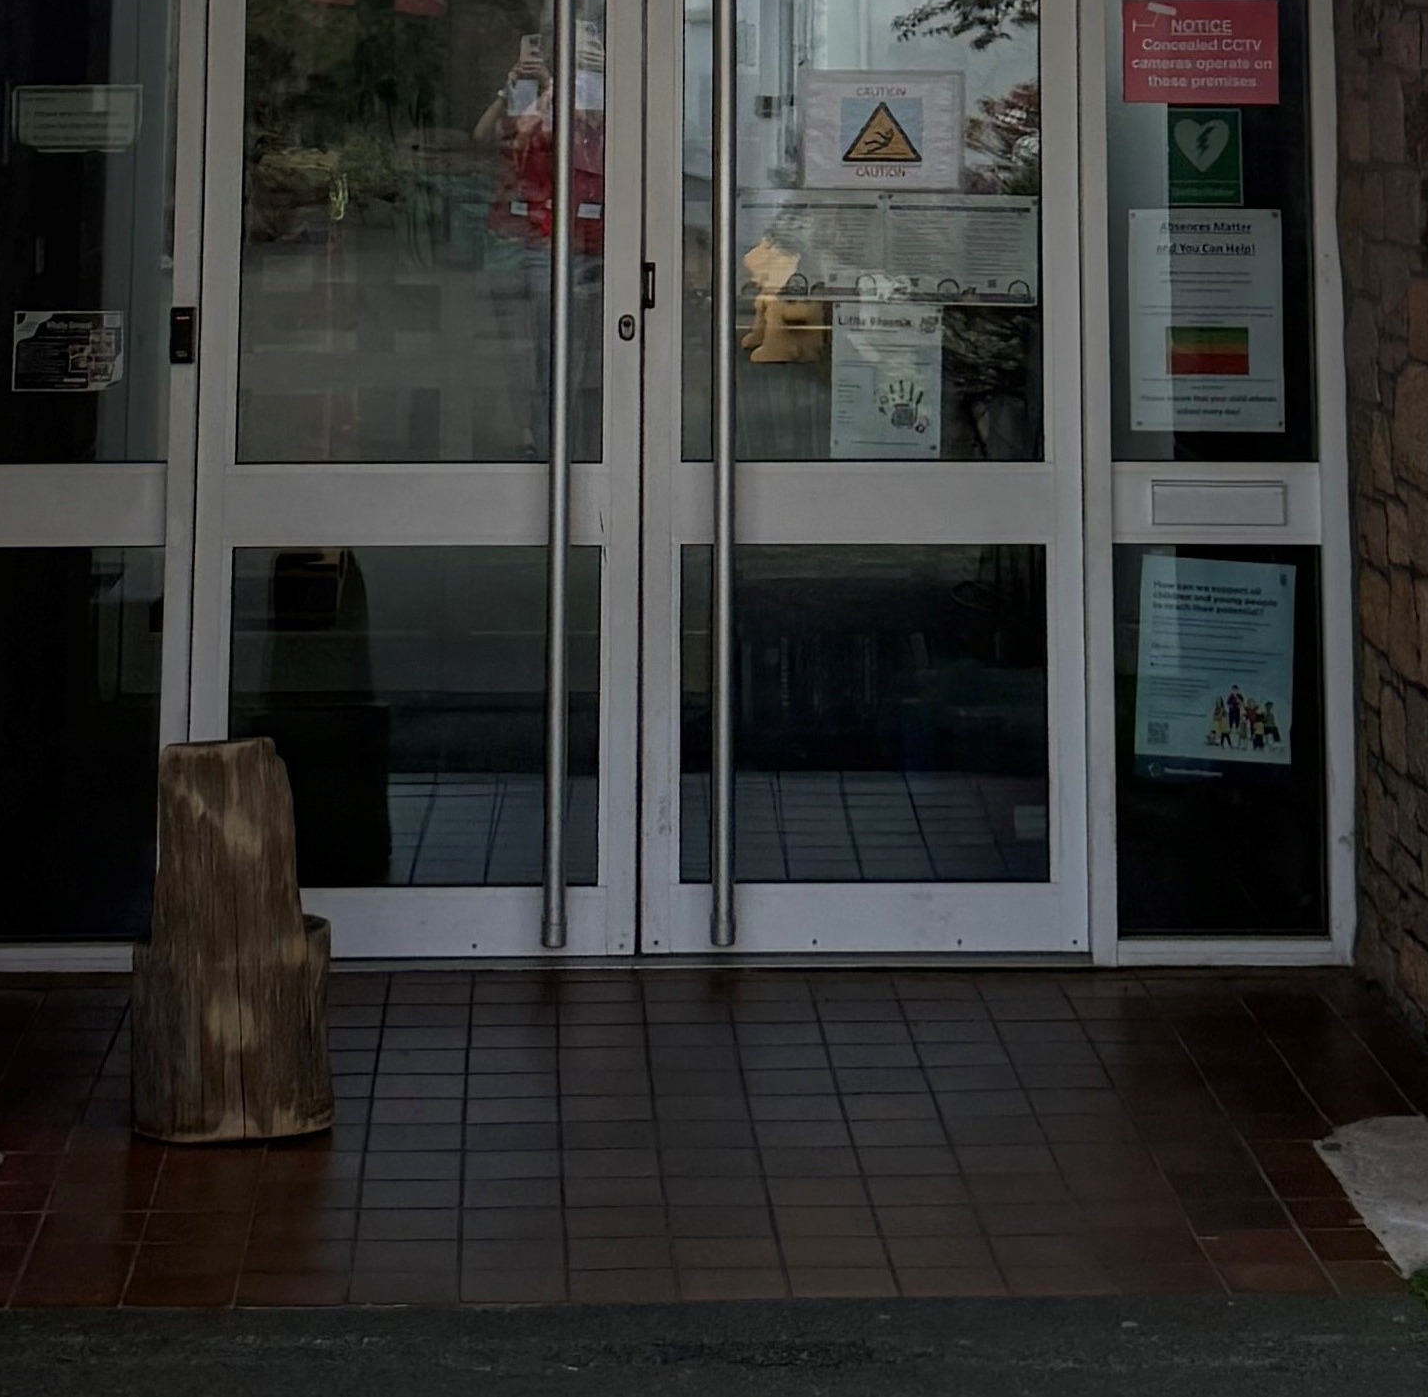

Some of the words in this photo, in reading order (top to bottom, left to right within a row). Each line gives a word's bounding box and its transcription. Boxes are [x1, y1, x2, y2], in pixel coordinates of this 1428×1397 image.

[1171, 19, 1233, 33] NOTICE
[1142, 38, 1217, 51] Concealed
[1222, 39, 1262, 51] CCTV
[1132, 59, 1192, 69] cameras
[1196, 58, 1250, 72] operate
[1254, 59, 1272, 70] on
[1148, 75, 1188, 87] these
[1191, 76, 1257, 89] premises
[856, 86, 907, 97] CAUTION
[856, 166, 906, 177] CAUTION
[1213, 222, 1251, 232] Matter
[1179, 244, 1200, 253] You
[1202, 244, 1223, 253] Can
[1225, 244, 1255, 255] Help!
